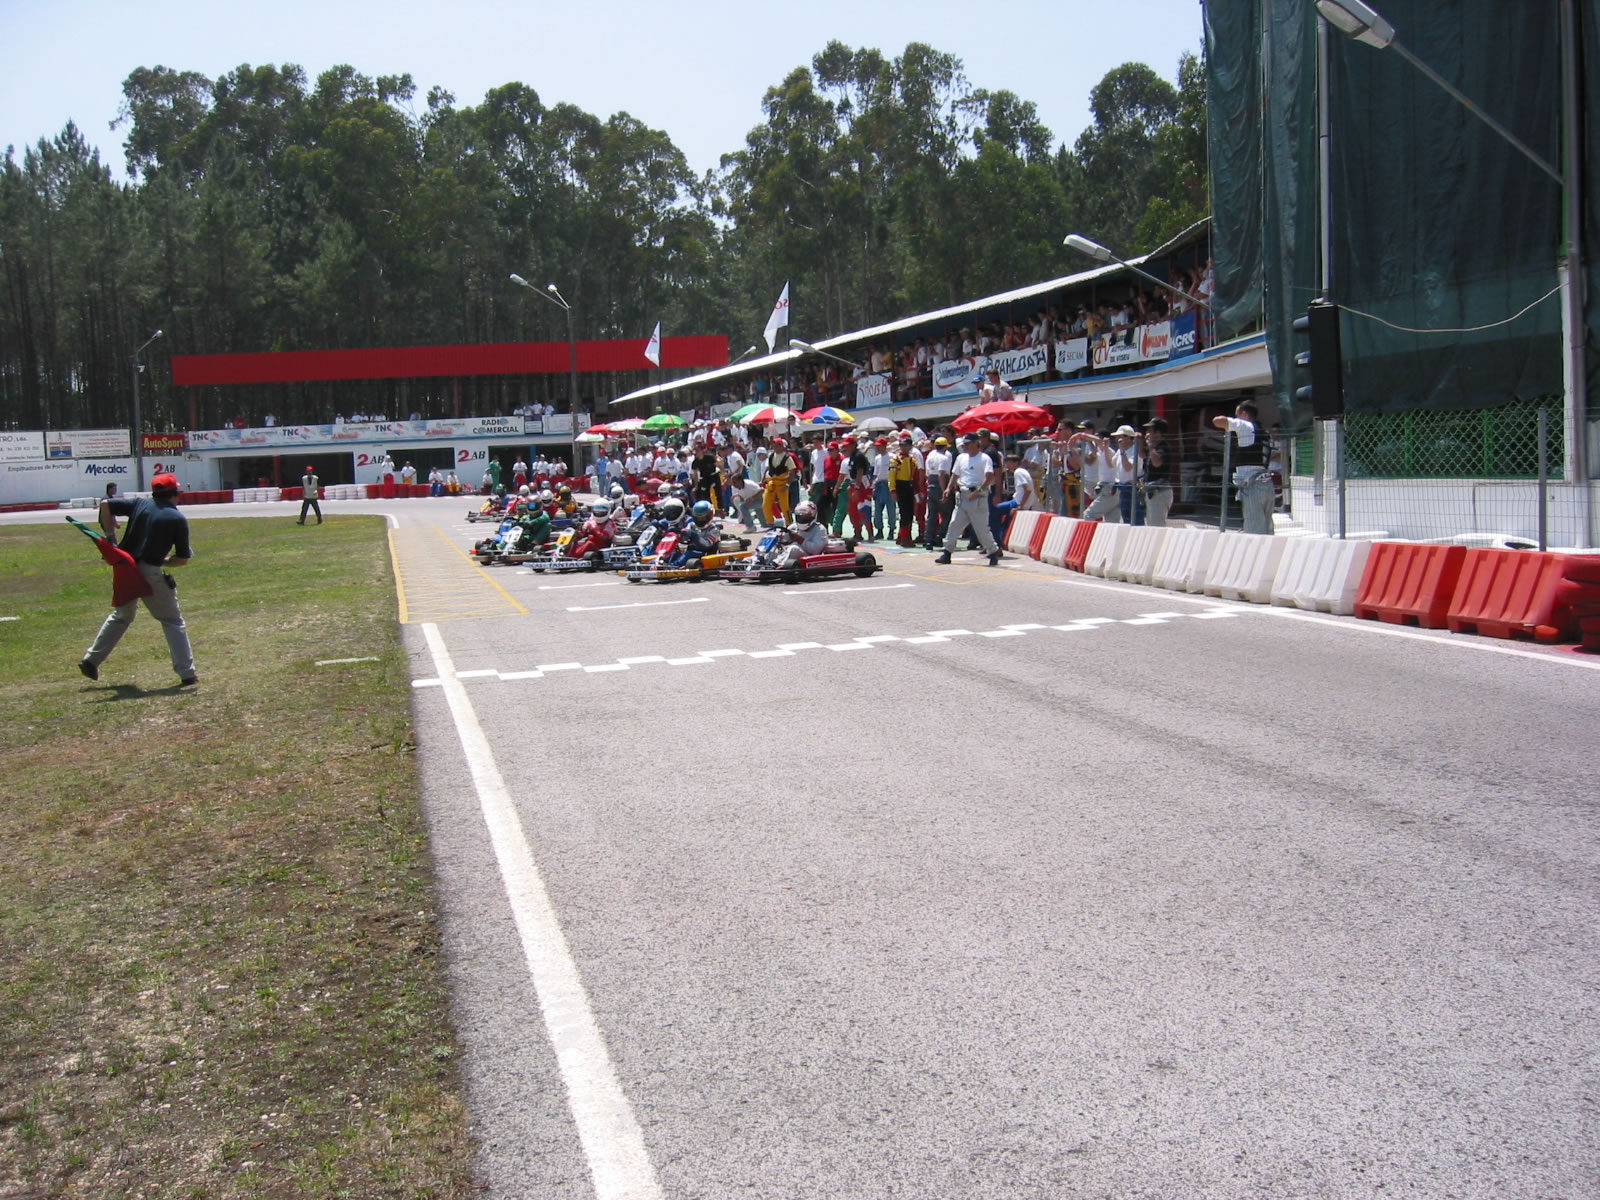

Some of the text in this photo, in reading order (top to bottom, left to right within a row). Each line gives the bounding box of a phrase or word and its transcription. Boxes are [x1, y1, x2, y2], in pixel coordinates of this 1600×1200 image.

[282, 428, 299, 436] TNC
[375, 424, 392, 432] TNC
[192, 433, 209, 441] TNC
[143, 437, 184, 450] AutoSport
[357, 454, 384, 466] 2 AB
[458, 450, 486, 462] 2 AB
[52, 463, 73, 471] Portugal
[85, 463, 128, 476] Mecalac
[153, 463, 176, 476] 2 AB
